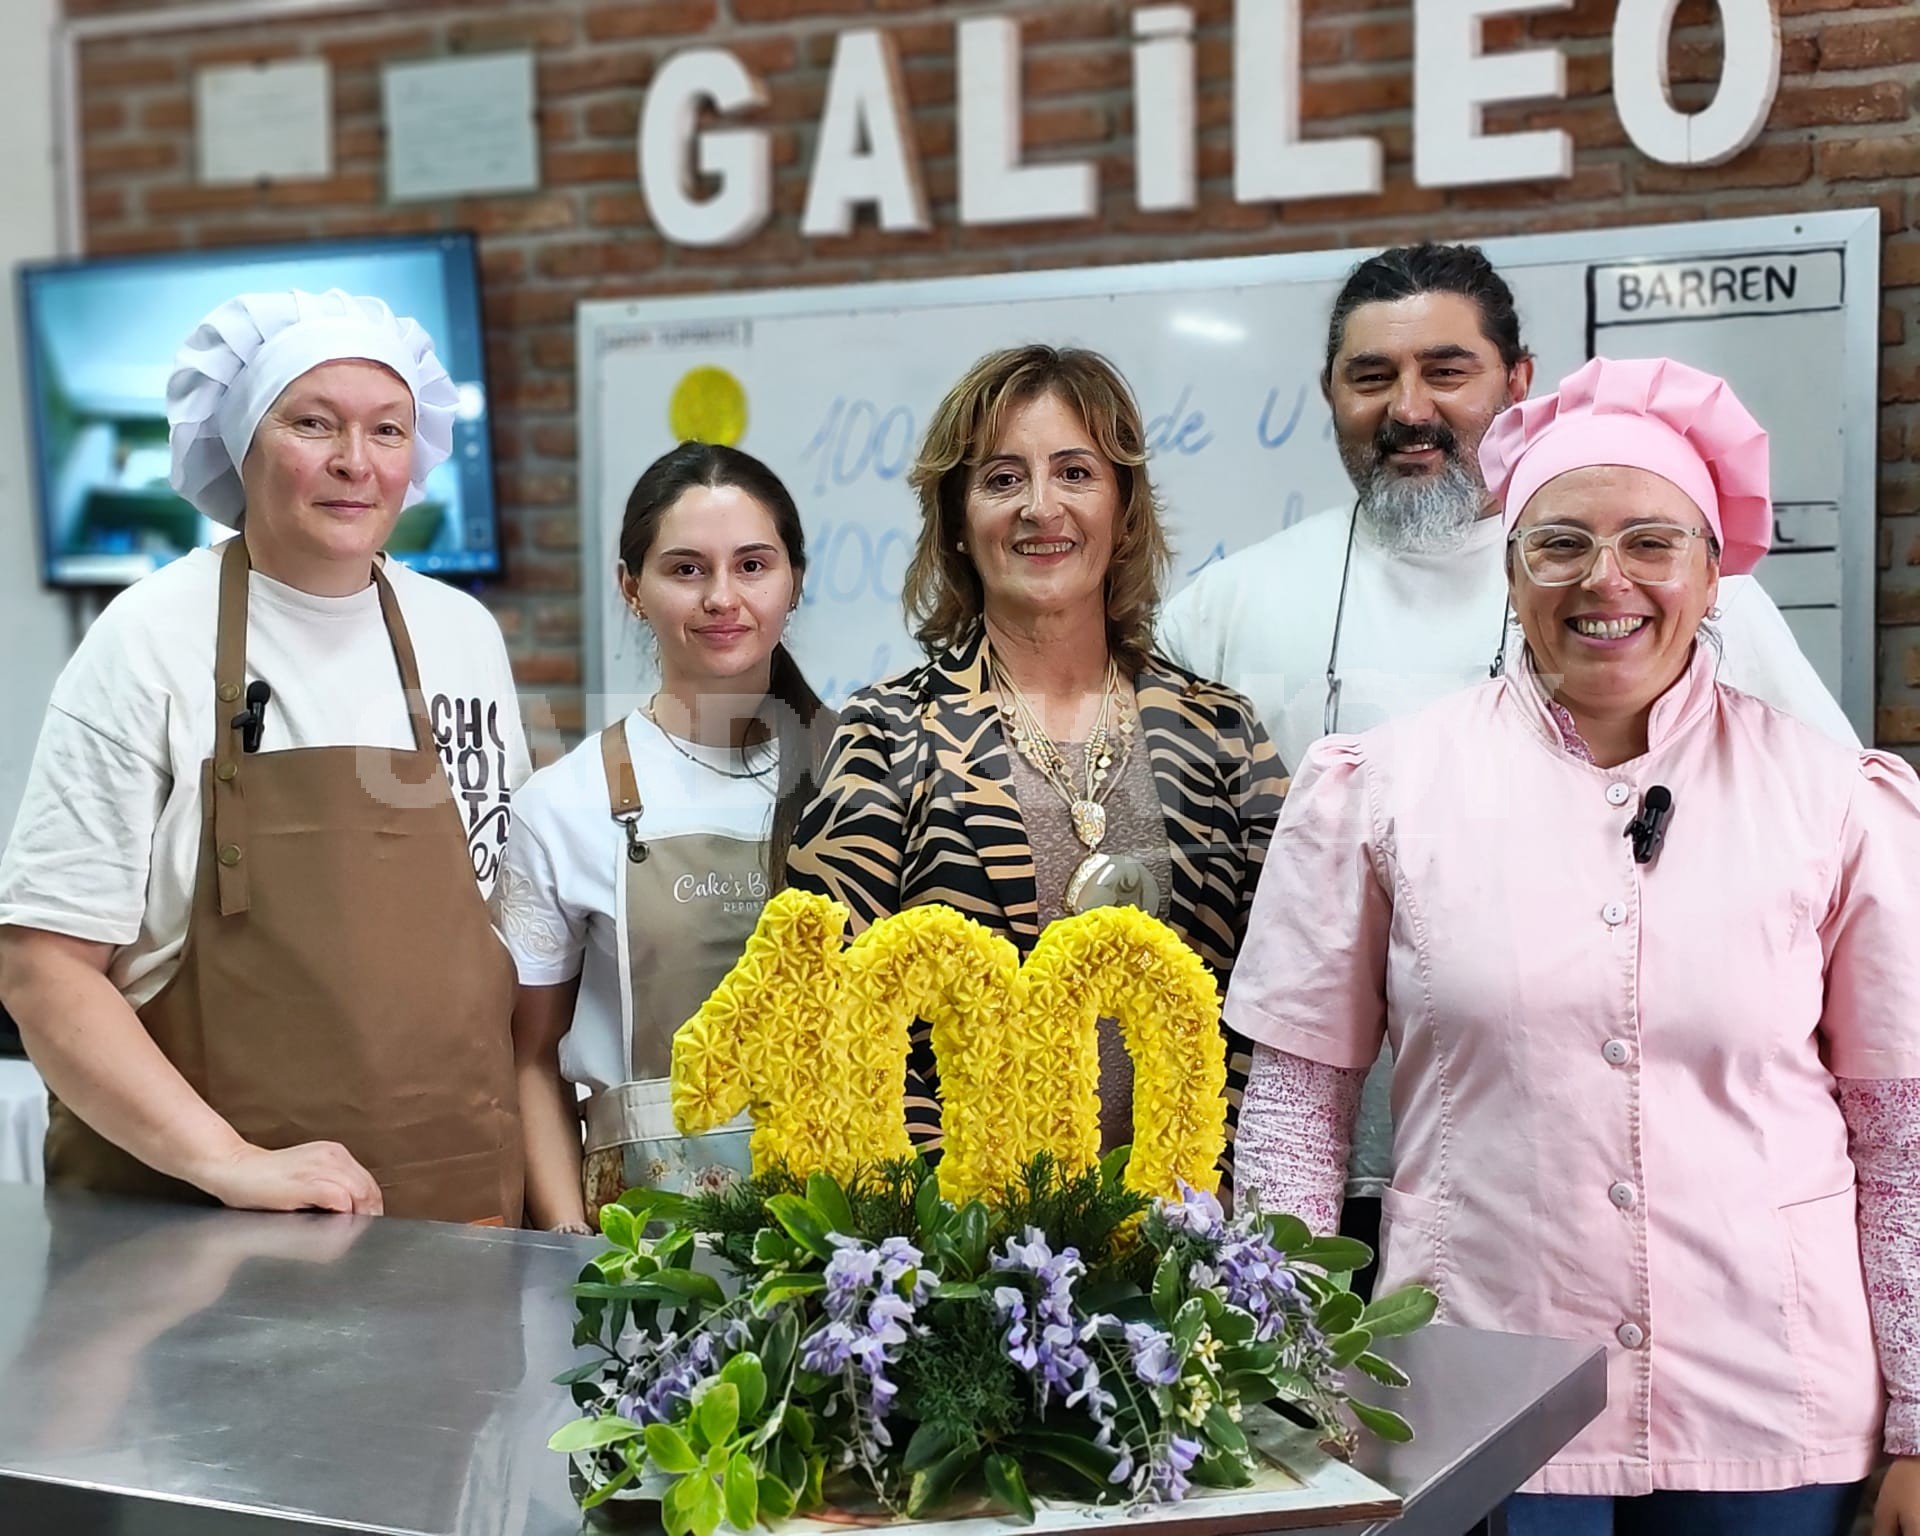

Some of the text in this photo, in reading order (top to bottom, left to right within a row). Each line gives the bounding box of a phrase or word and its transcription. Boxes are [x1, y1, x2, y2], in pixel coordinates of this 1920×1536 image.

[1617, 264, 1797, 312] BARREN
[801, 395, 917, 496] 100
[673, 871, 742, 903] Cake's
[671, 888, 1229, 1208] 100
